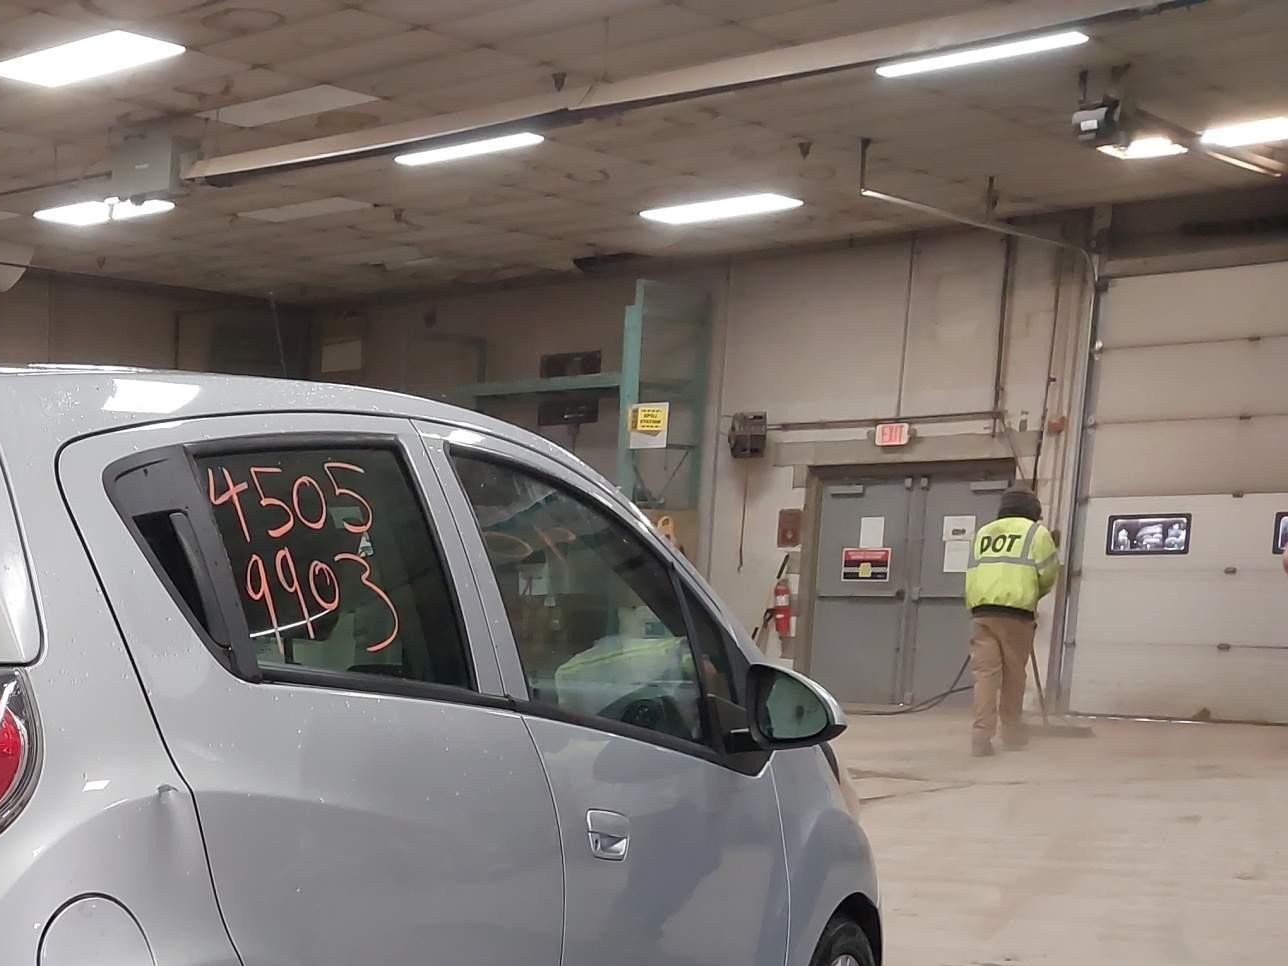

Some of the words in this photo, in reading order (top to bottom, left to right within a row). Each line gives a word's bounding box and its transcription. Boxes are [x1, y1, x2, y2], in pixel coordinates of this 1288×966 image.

[881, 424, 904, 443] EXIT
[207, 462, 373, 543] 4505
[980, 534, 1022, 555] DOT
[246, 547, 400, 655] 9903
